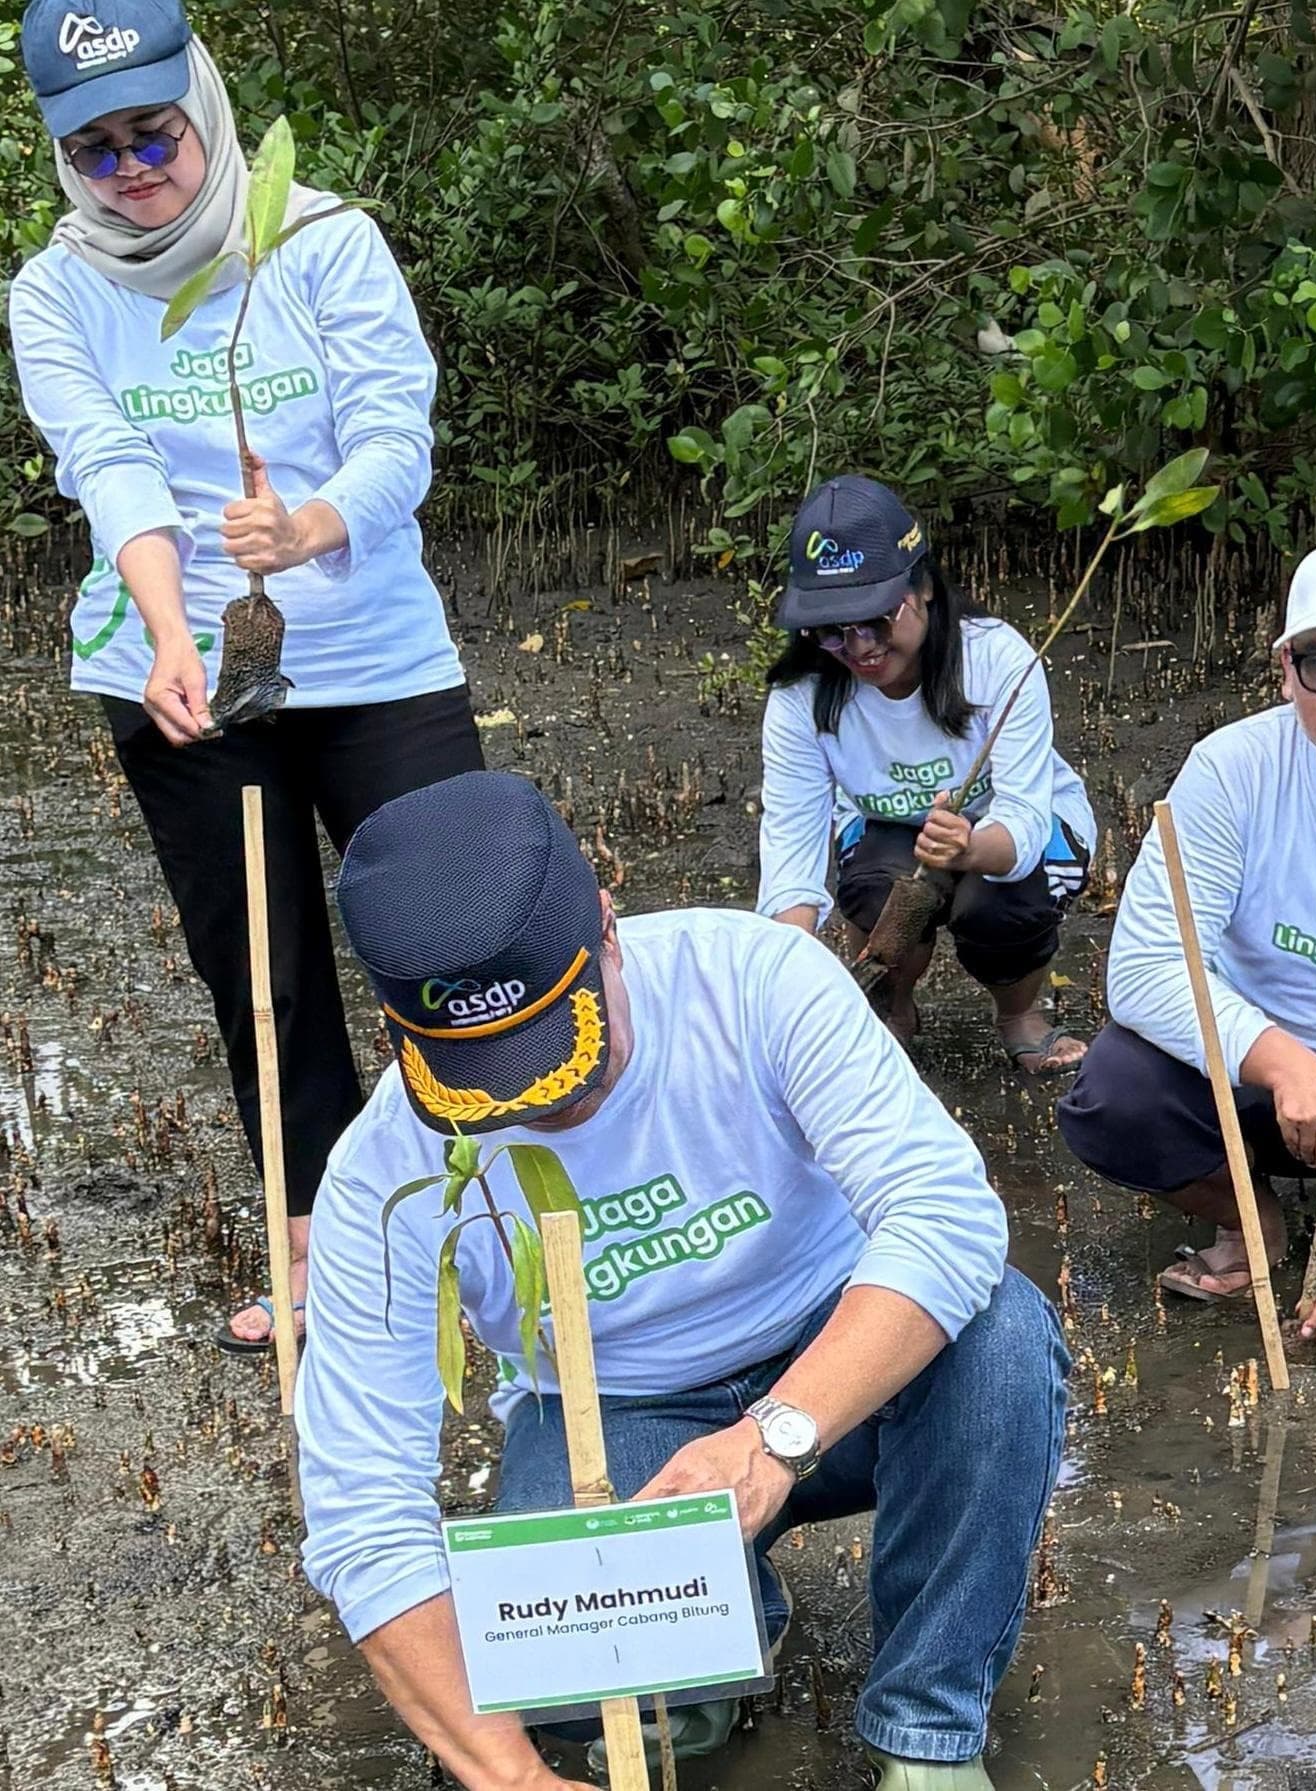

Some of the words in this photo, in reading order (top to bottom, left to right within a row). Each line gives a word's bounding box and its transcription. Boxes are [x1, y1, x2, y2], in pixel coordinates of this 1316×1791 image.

[77, 27, 140, 60] asdp
[174, 343, 252, 381] Jaga
[819, 549, 864, 570] asdp
[891, 758, 951, 787] Jaga
[448, 980, 525, 1017] asdp
[583, 1178, 681, 1236] Jaga
[498, 1597, 568, 1622] Rudy
[575, 1576, 709, 1613] Mahmudi
[485, 1625, 543, 1643] General
[547, 1617, 614, 1636] Manager
[617, 1609, 678, 1627] Cabang
[682, 1603, 729, 1619] Bitung
